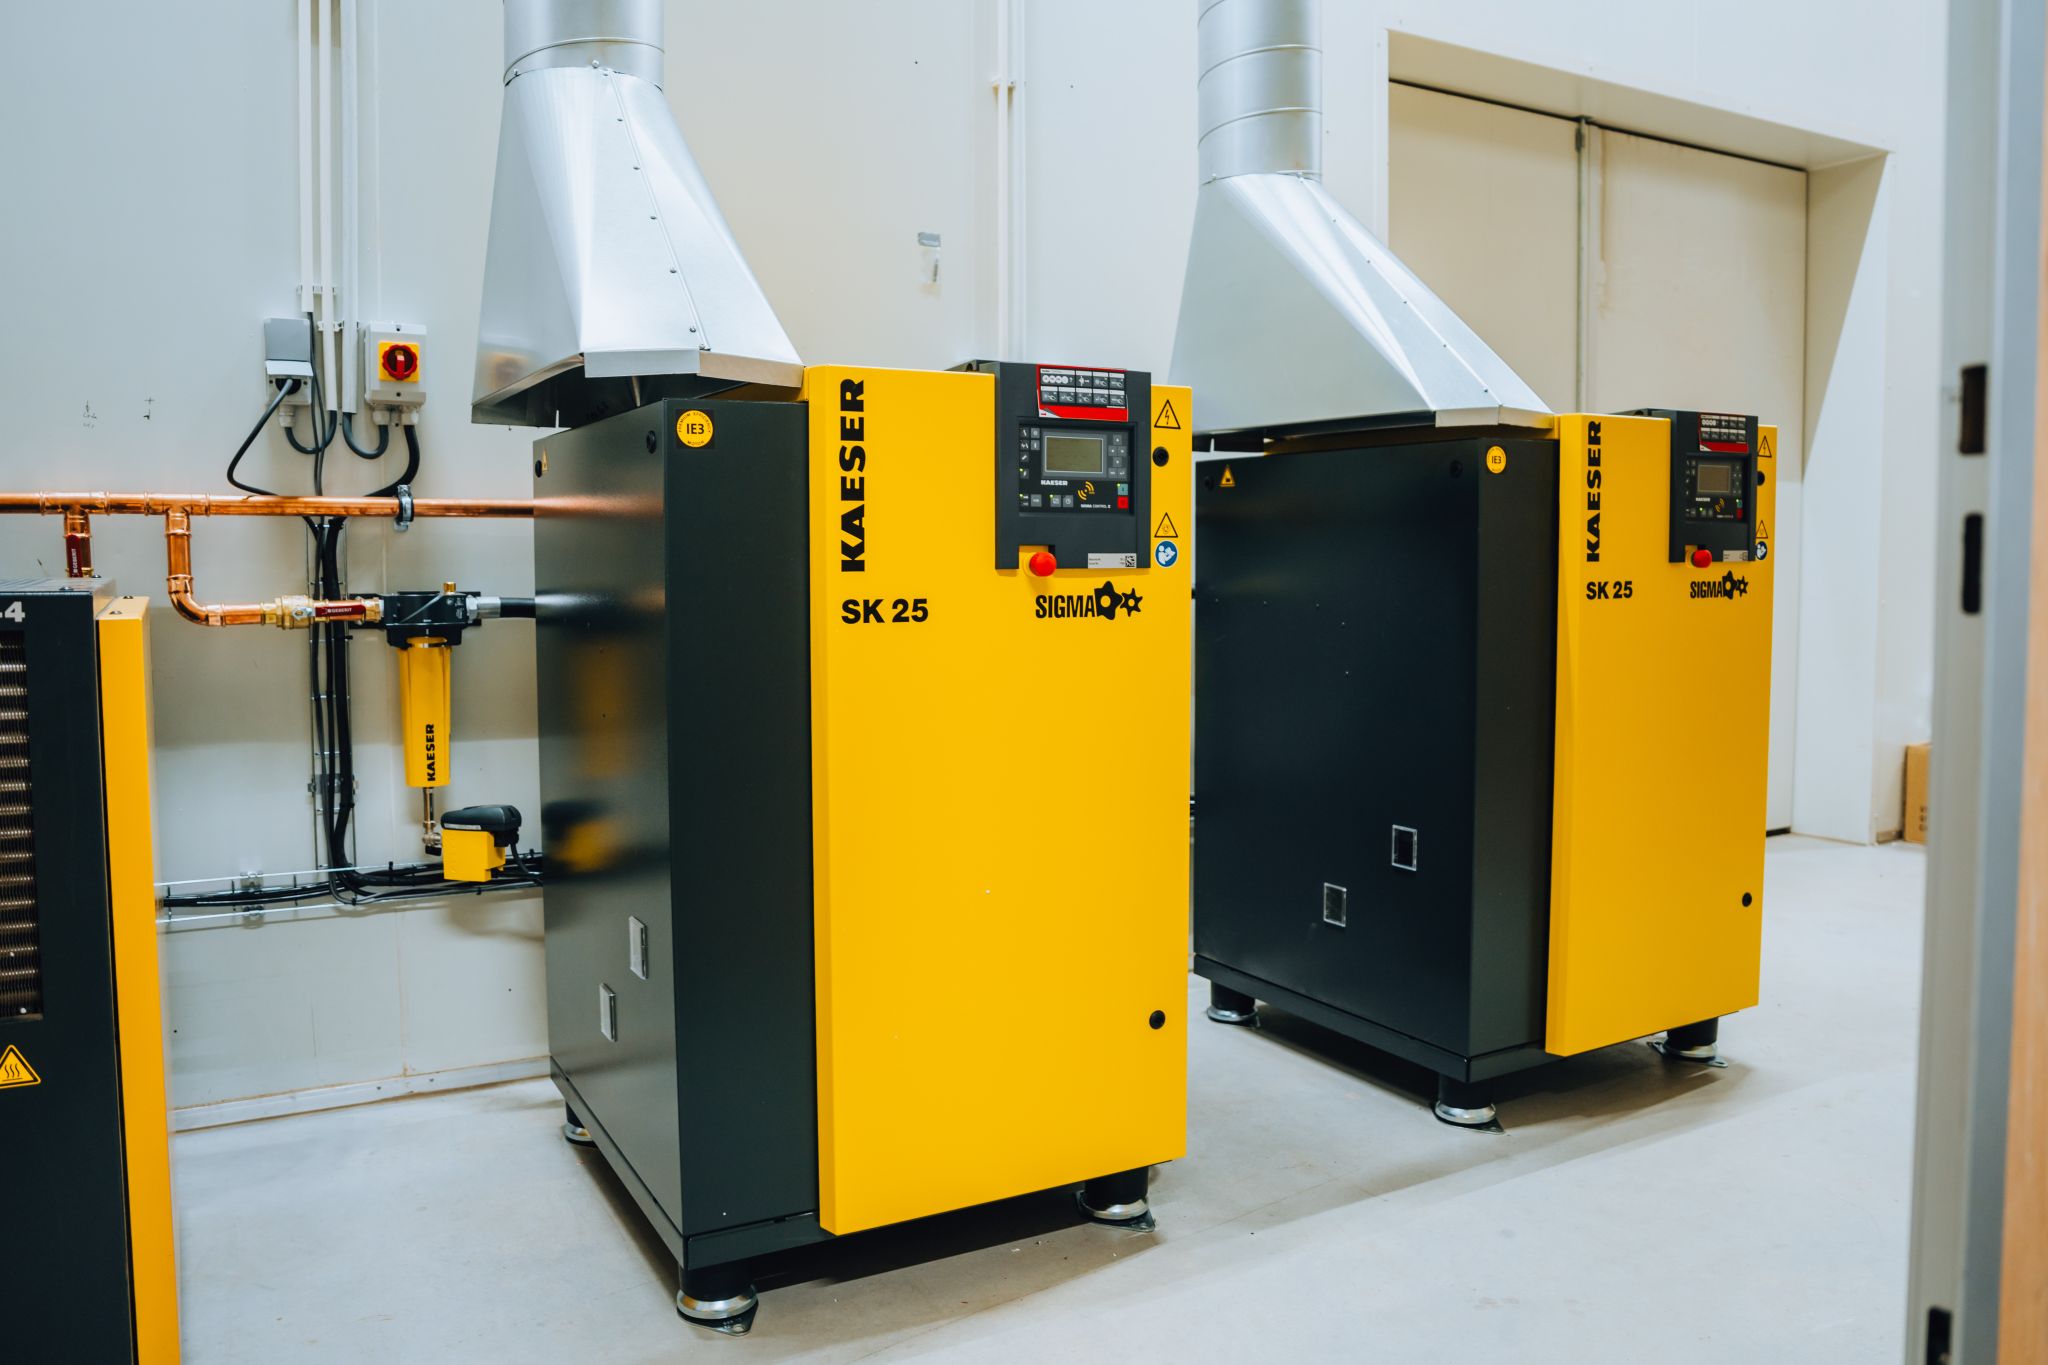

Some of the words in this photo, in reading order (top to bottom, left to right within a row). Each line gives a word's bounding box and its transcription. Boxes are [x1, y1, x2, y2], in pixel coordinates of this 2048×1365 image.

[686, 423, 704, 434] IE3
[1491, 455, 1502, 464] IE3
[839, 378, 866, 572] KAESER
[1586, 420, 1602, 562] KAESER
[1586, 581, 1609, 600] SK
[1613, 580, 1633, 599] 25
[1690, 580, 1722, 598] SIGMA
[841, 599, 885, 624] SK
[892, 598, 928, 622] 25
[1035, 594, 1095, 619] SIGMA
[426, 723, 436, 781] KAESER
